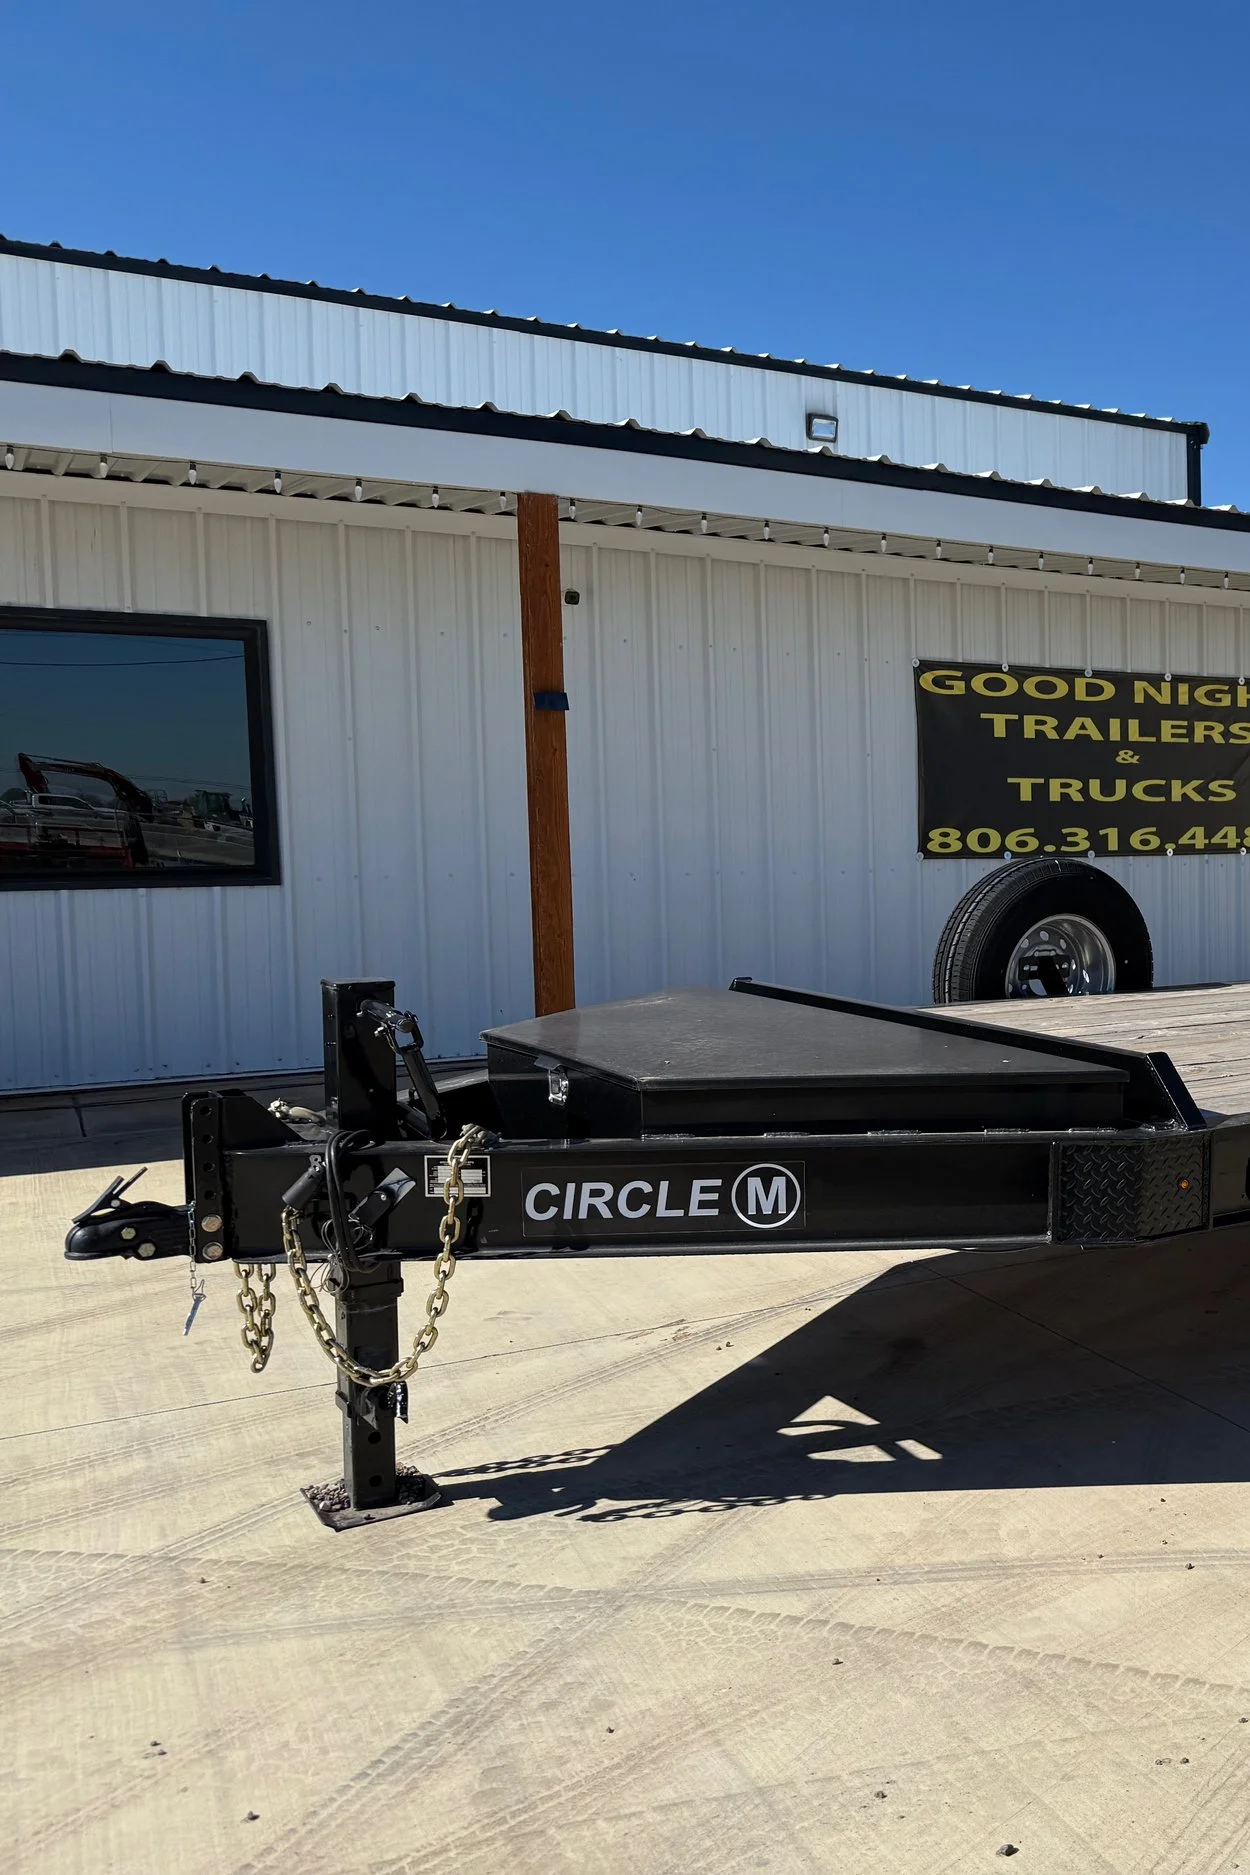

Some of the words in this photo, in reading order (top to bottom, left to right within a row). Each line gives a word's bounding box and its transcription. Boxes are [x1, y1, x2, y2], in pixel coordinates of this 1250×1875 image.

[919, 670, 1116, 702] GOOD
[1115, 750, 1140, 764] &
[1007, 777, 1237, 802] TRUCKS
[525, 1179, 722, 1221] CIRCLE
[747, 1176, 787, 1215] M
